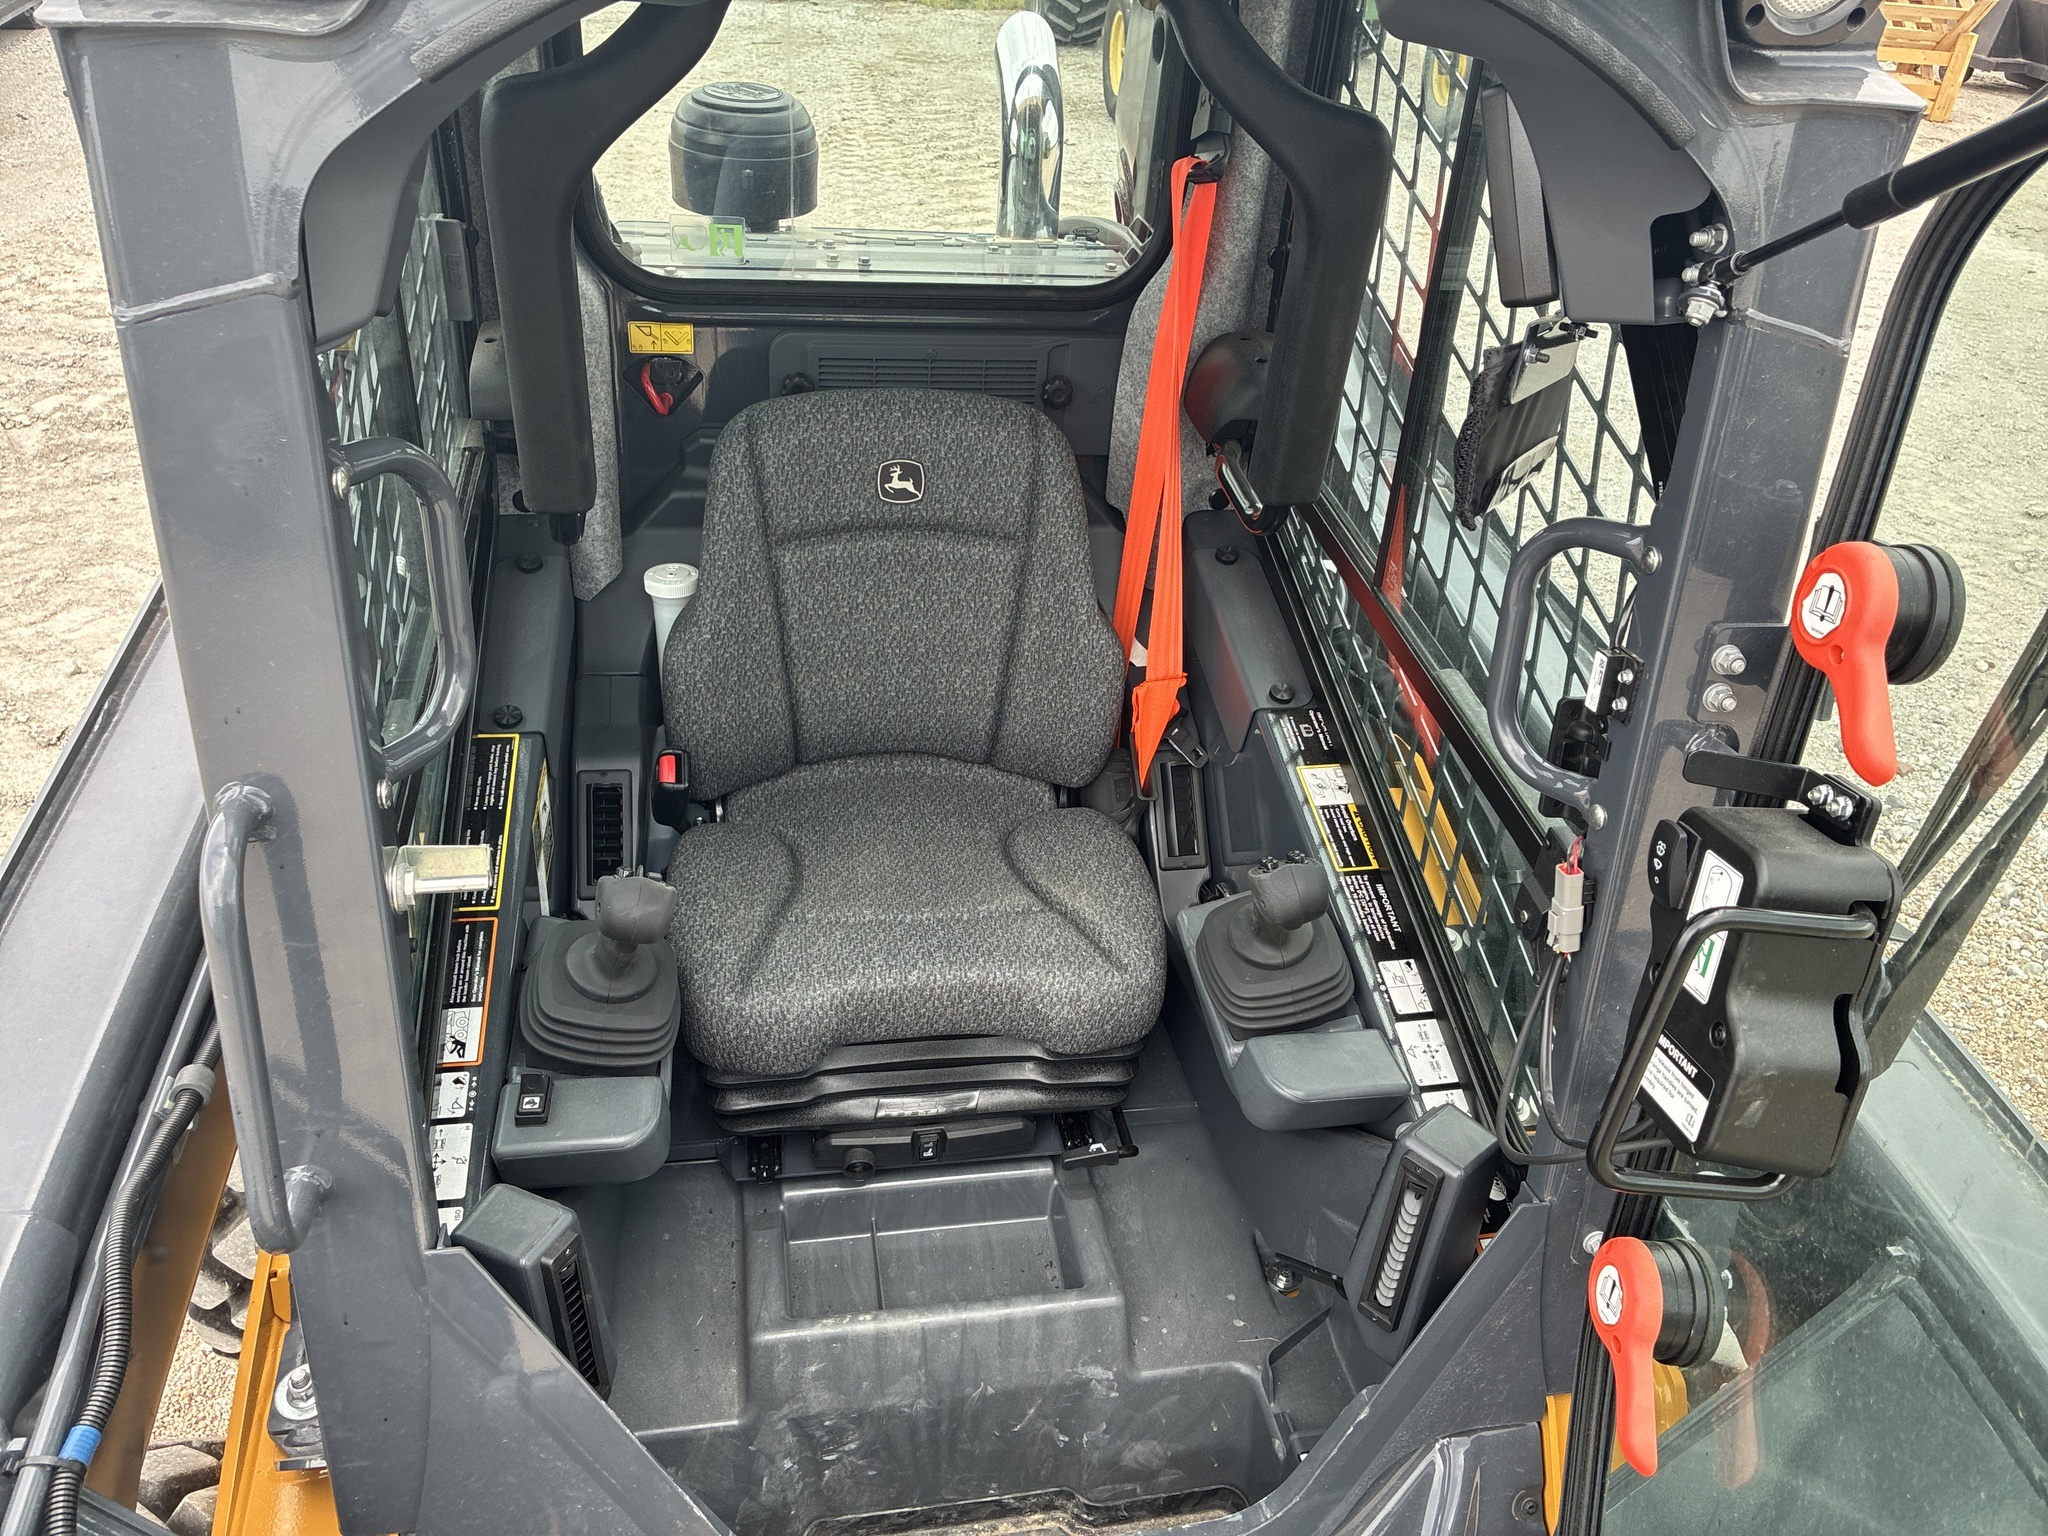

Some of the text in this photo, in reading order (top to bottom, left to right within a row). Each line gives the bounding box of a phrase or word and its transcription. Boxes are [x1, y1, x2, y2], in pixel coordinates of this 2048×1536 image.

[1309, 710, 1329, 750] Operator's Manual
[1340, 805, 1358, 841] Avoid Overturn
[1340, 876, 1351, 899] operation
[1351, 905, 1361, 925] controls.
[1351, 875, 1359, 889] below
[1355, 900, 1365, 918] minutes
[1363, 919, 1371, 935] before
[1364, 881, 1376, 899] prevent
[1373, 899, 1383, 918] damage
[1383, 925, 1396, 950] hydraulics
[1370, 908, 1385, 939] temperatures
[1376, 884, 1401, 931] IMPORTANT
[1659, 1035, 1697, 1077] MPORTANT
[1651, 1062, 1662, 1074] range
[1662, 1073, 1677, 1091] handles
[1684, 1097, 1698, 1114] turned.
[1653, 1074, 1669, 1092] required
[1658, 1058, 1671, 1074] release
[1671, 1071, 1681, 1084] from
[1681, 1082, 1694, 1099] hinges
